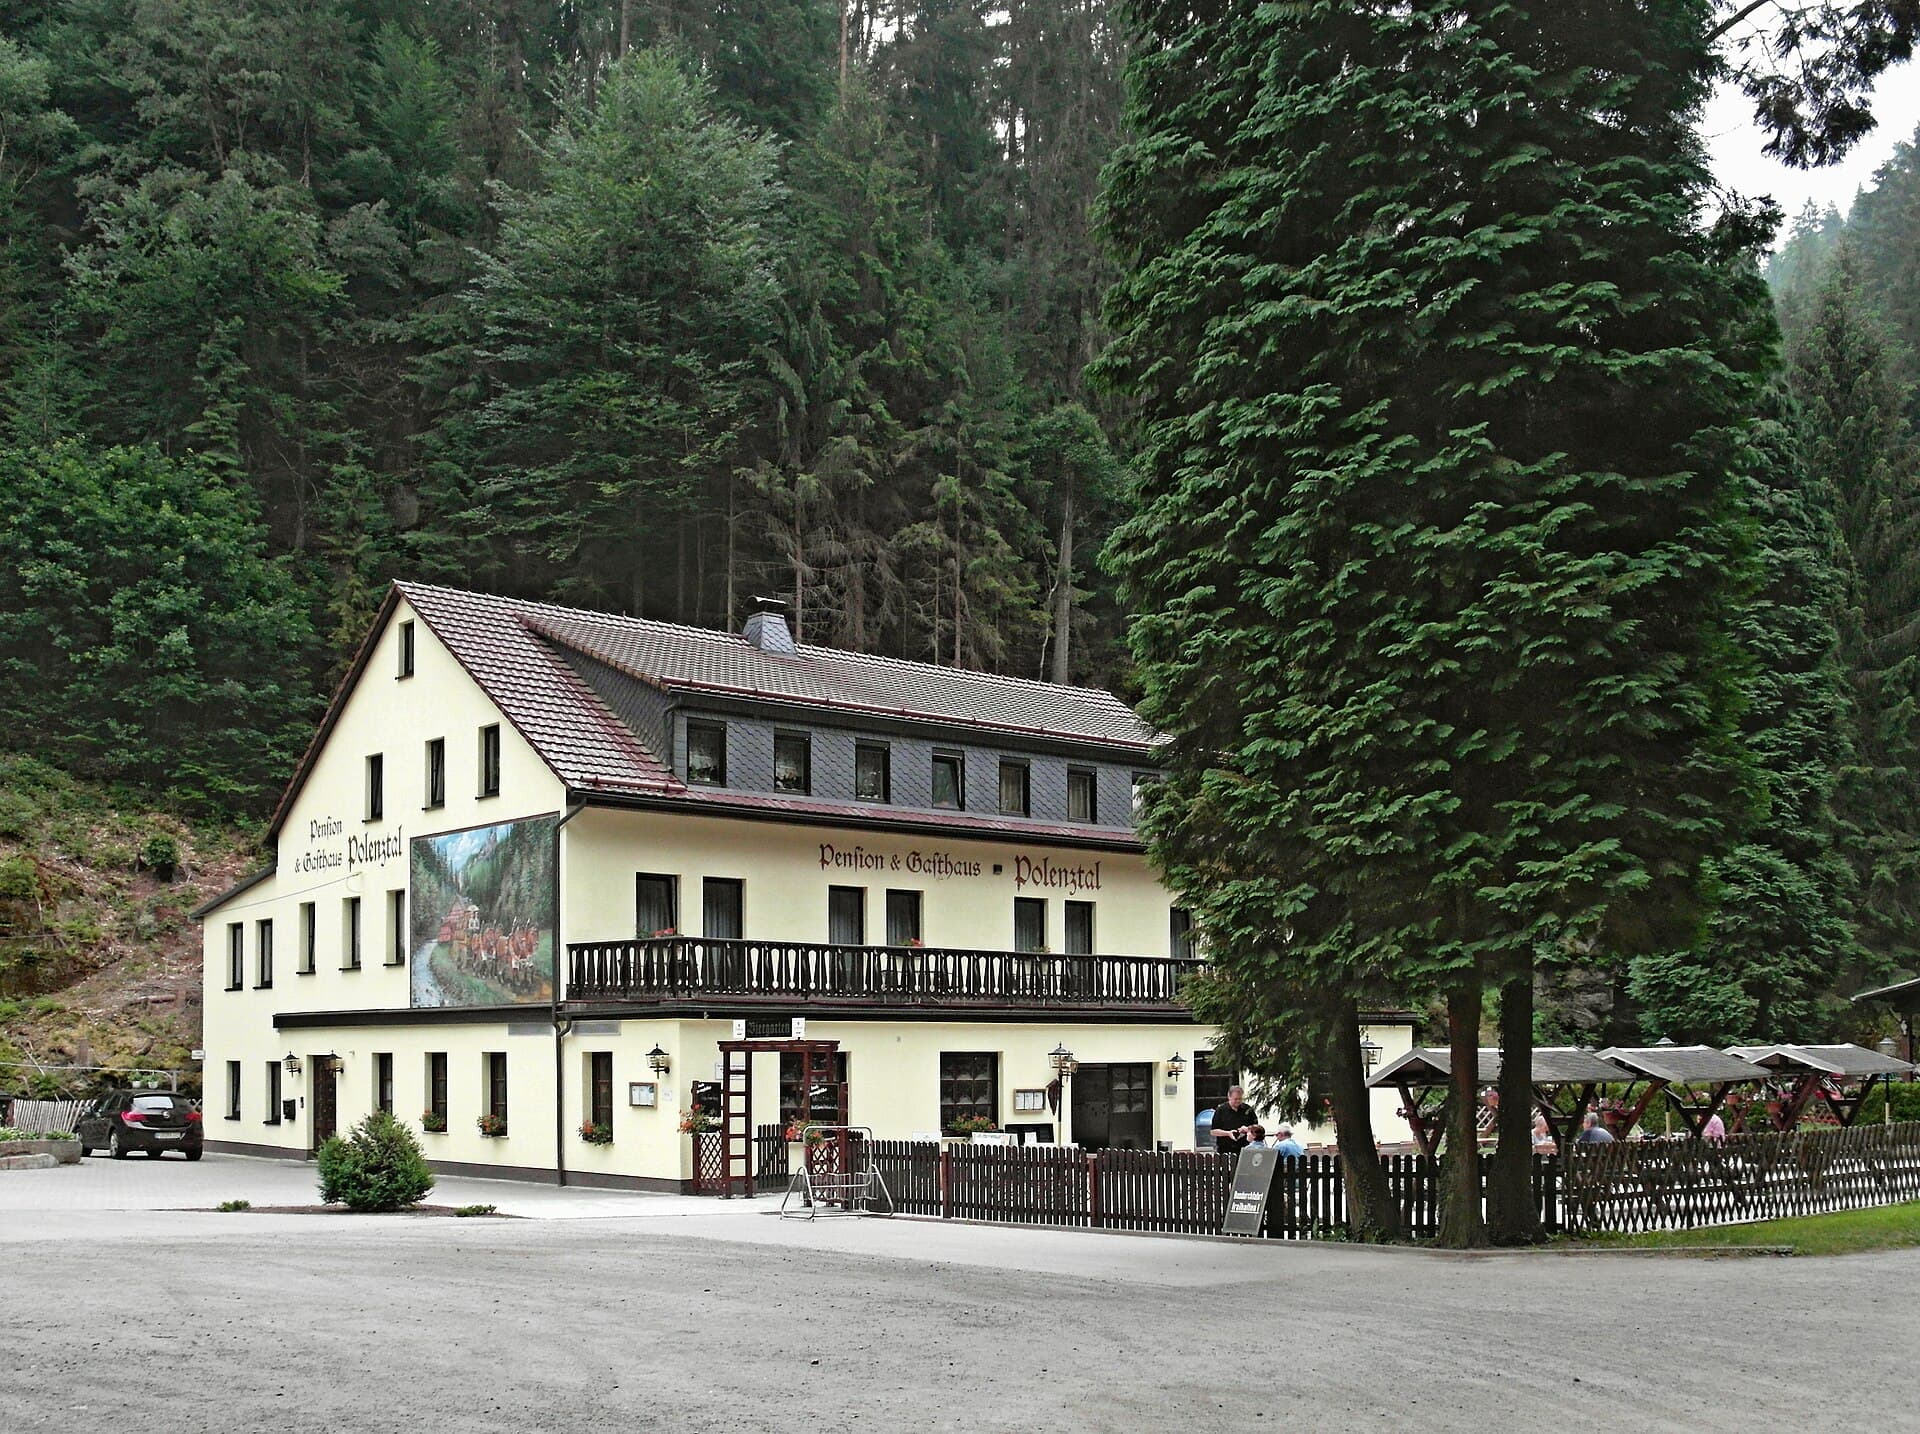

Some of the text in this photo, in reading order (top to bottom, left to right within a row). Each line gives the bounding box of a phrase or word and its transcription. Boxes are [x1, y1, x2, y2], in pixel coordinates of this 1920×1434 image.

[347, 824, 403, 873] Polenztal
[295, 858, 301, 873] &
[890, 854, 901, 871] &
[1014, 854, 1102, 895] Polenztal
[747, 1021, 790, 1036] Biergarten
